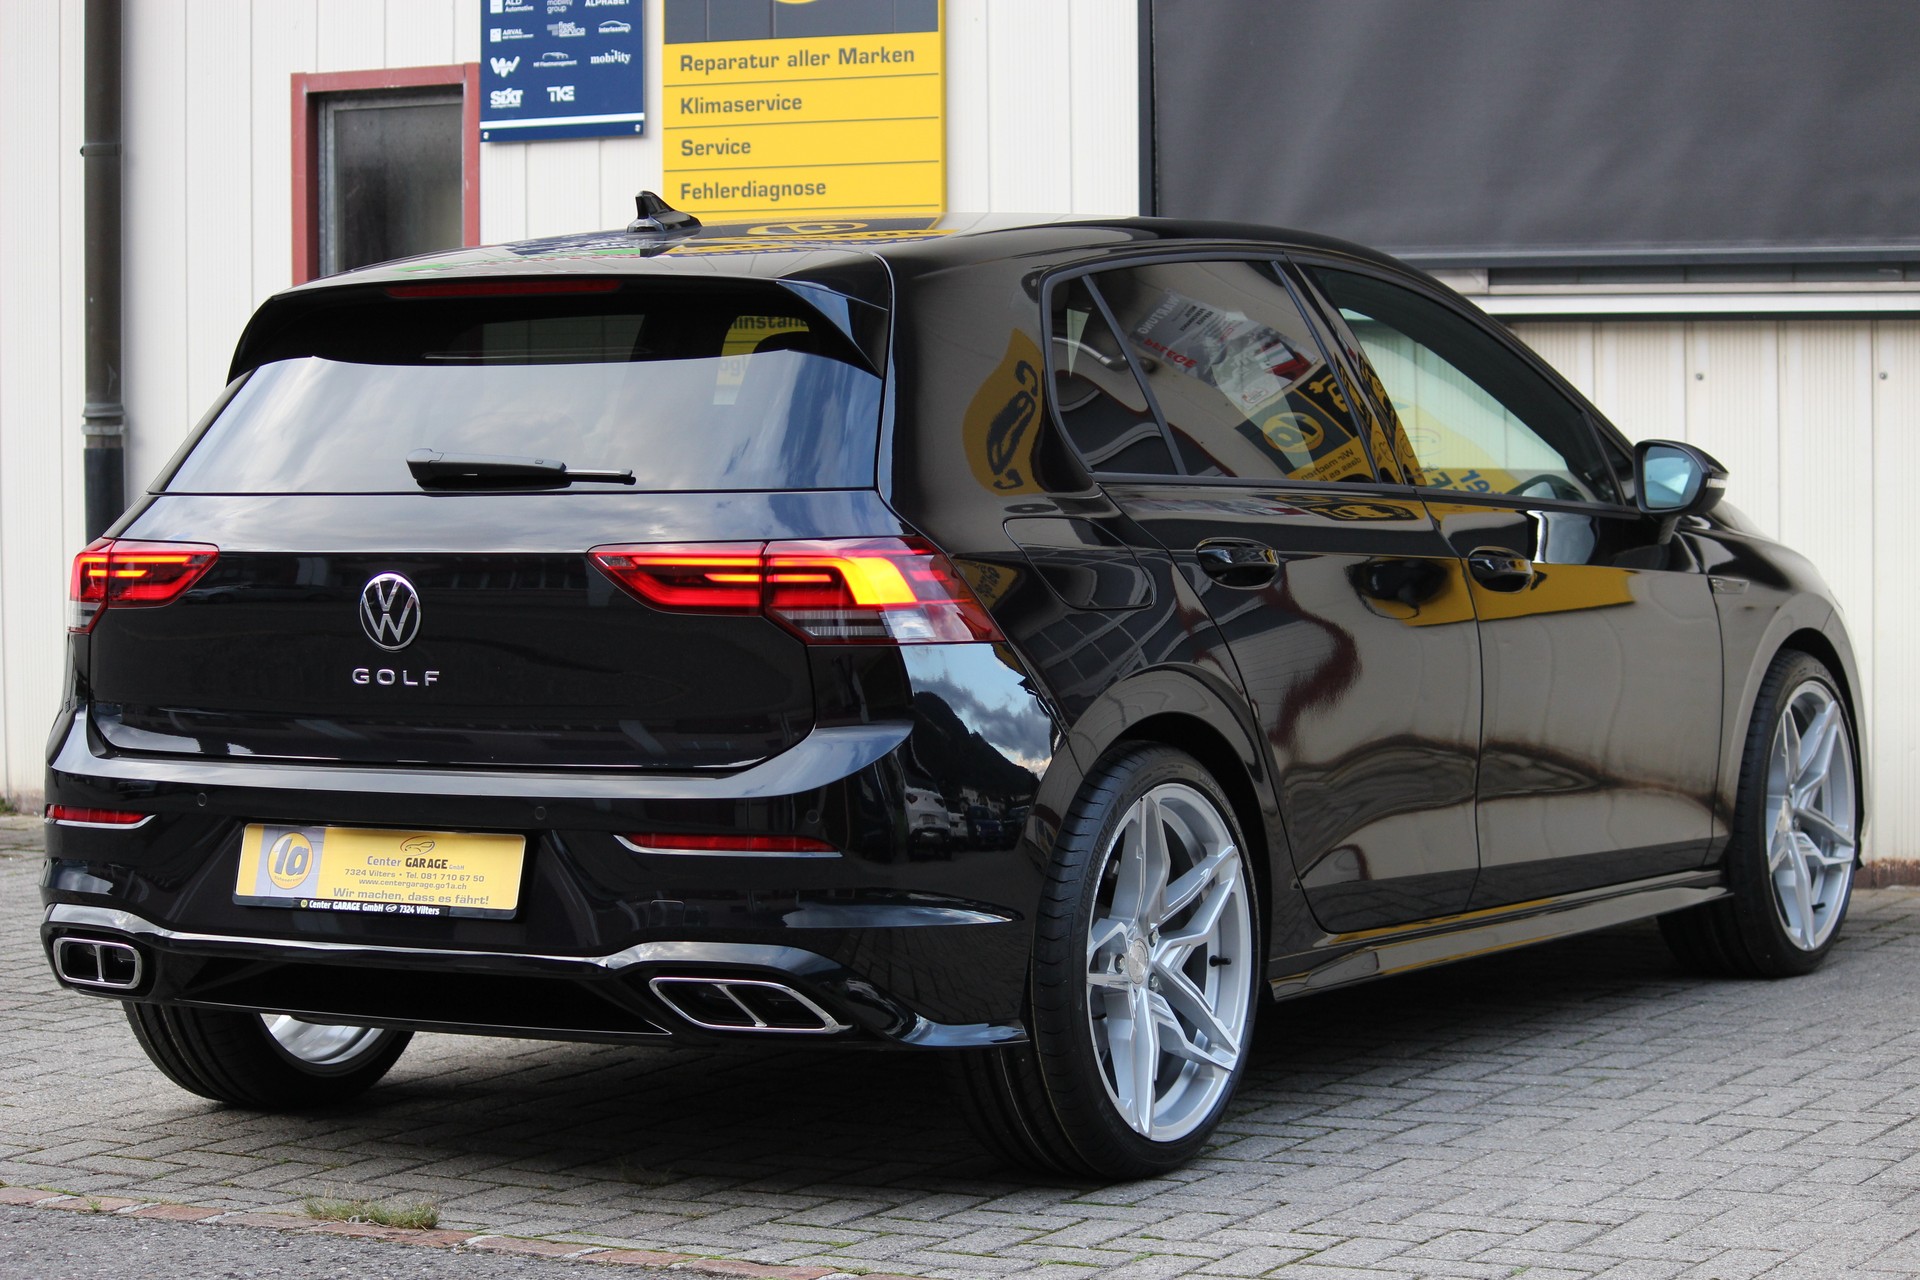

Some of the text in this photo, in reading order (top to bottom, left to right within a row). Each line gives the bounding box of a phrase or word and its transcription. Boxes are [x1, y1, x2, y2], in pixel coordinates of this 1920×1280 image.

[590, 49, 632, 65] mobility
[680, 46, 915, 75] Reparatur aller Marken
[680, 94, 803, 114] Klimaservice
[681, 138, 751, 156] Service
[680, 181, 827, 202] Fehlerdiagnose
[352, 668, 440, 686] GOLF
[367, 856, 401, 867] Center
[405, 857, 448, 869] GARAGE
[369, 869, 396, 878] Vilters
[421, 872, 438, 880] 081
[441, 873, 457, 881] 710
[359, 879, 467, 890] www.centergarage.go1a.ch
[333, 887, 355, 898] Wir
[358, 889, 404, 902] machen,
[408, 892, 435, 902] dass
[455, 894, 490, 905] fährt!
[309, 900, 331, 909] Center
[333, 901, 361, 911] GARAGE
[363, 903, 384, 912] GmbH
[399, 905, 415, 914] 7324
[416, 905, 440, 915] Vilters
